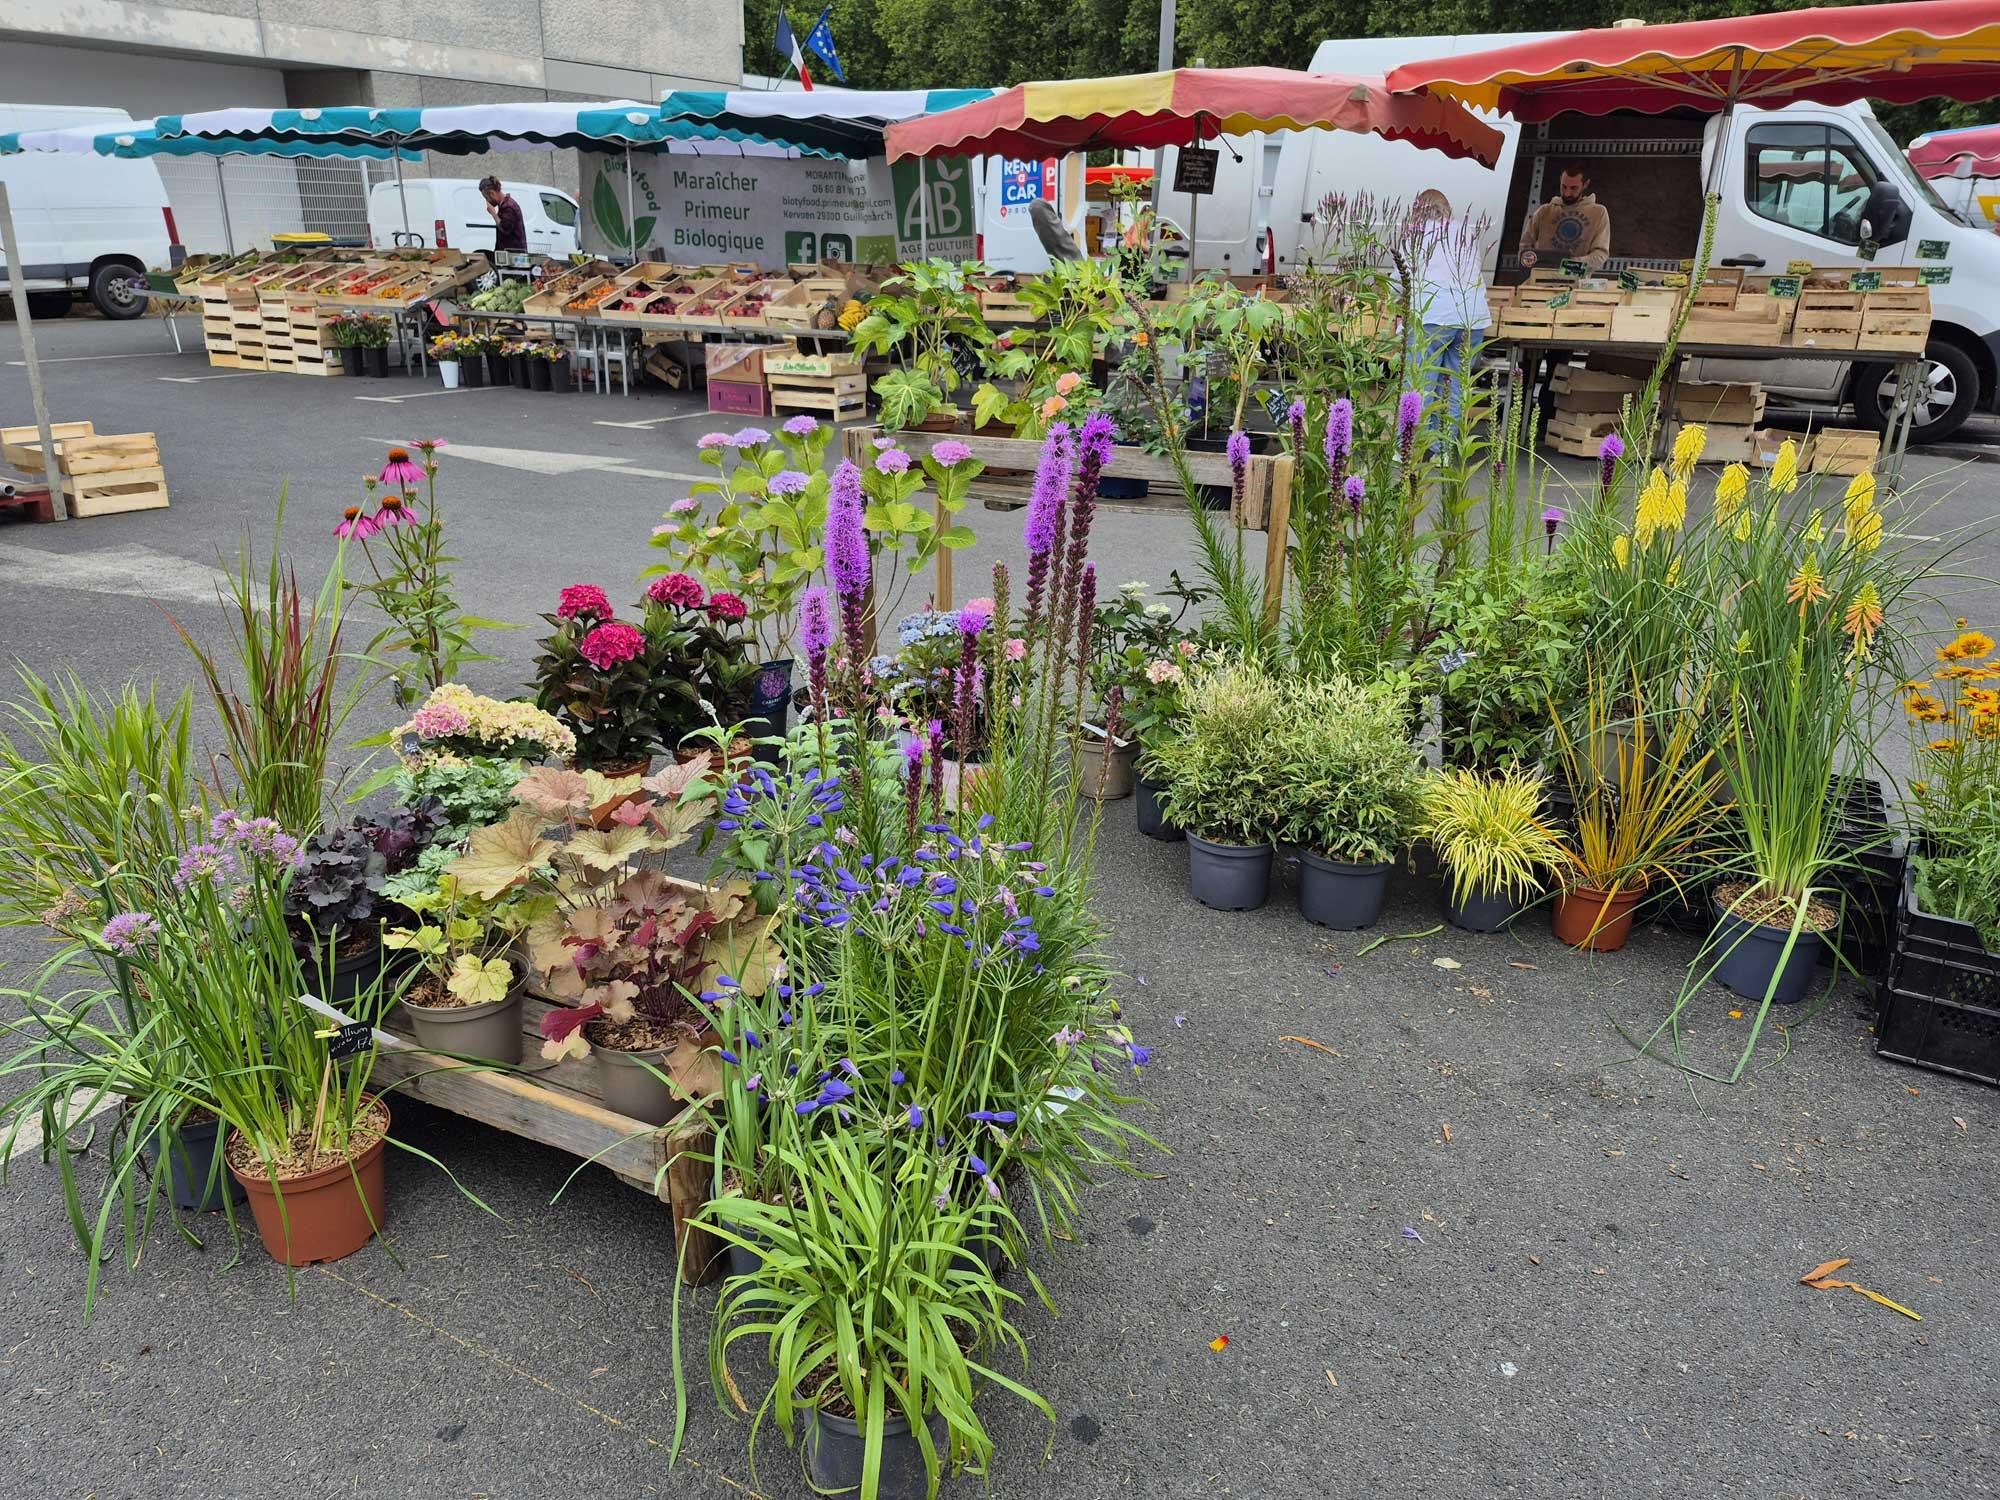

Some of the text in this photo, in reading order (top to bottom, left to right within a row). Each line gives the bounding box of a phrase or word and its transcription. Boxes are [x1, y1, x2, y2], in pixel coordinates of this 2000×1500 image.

[673, 170, 758, 192] Maraîcher
[1006, 183, 1036, 201] CAR
[685, 200, 750, 220] Primeur
[904, 181, 962, 237] AB
[674, 228, 765, 253] Biologique
[901, 240, 975, 255] AGRCULTURE
[341, 1026, 368, 1039] llium
